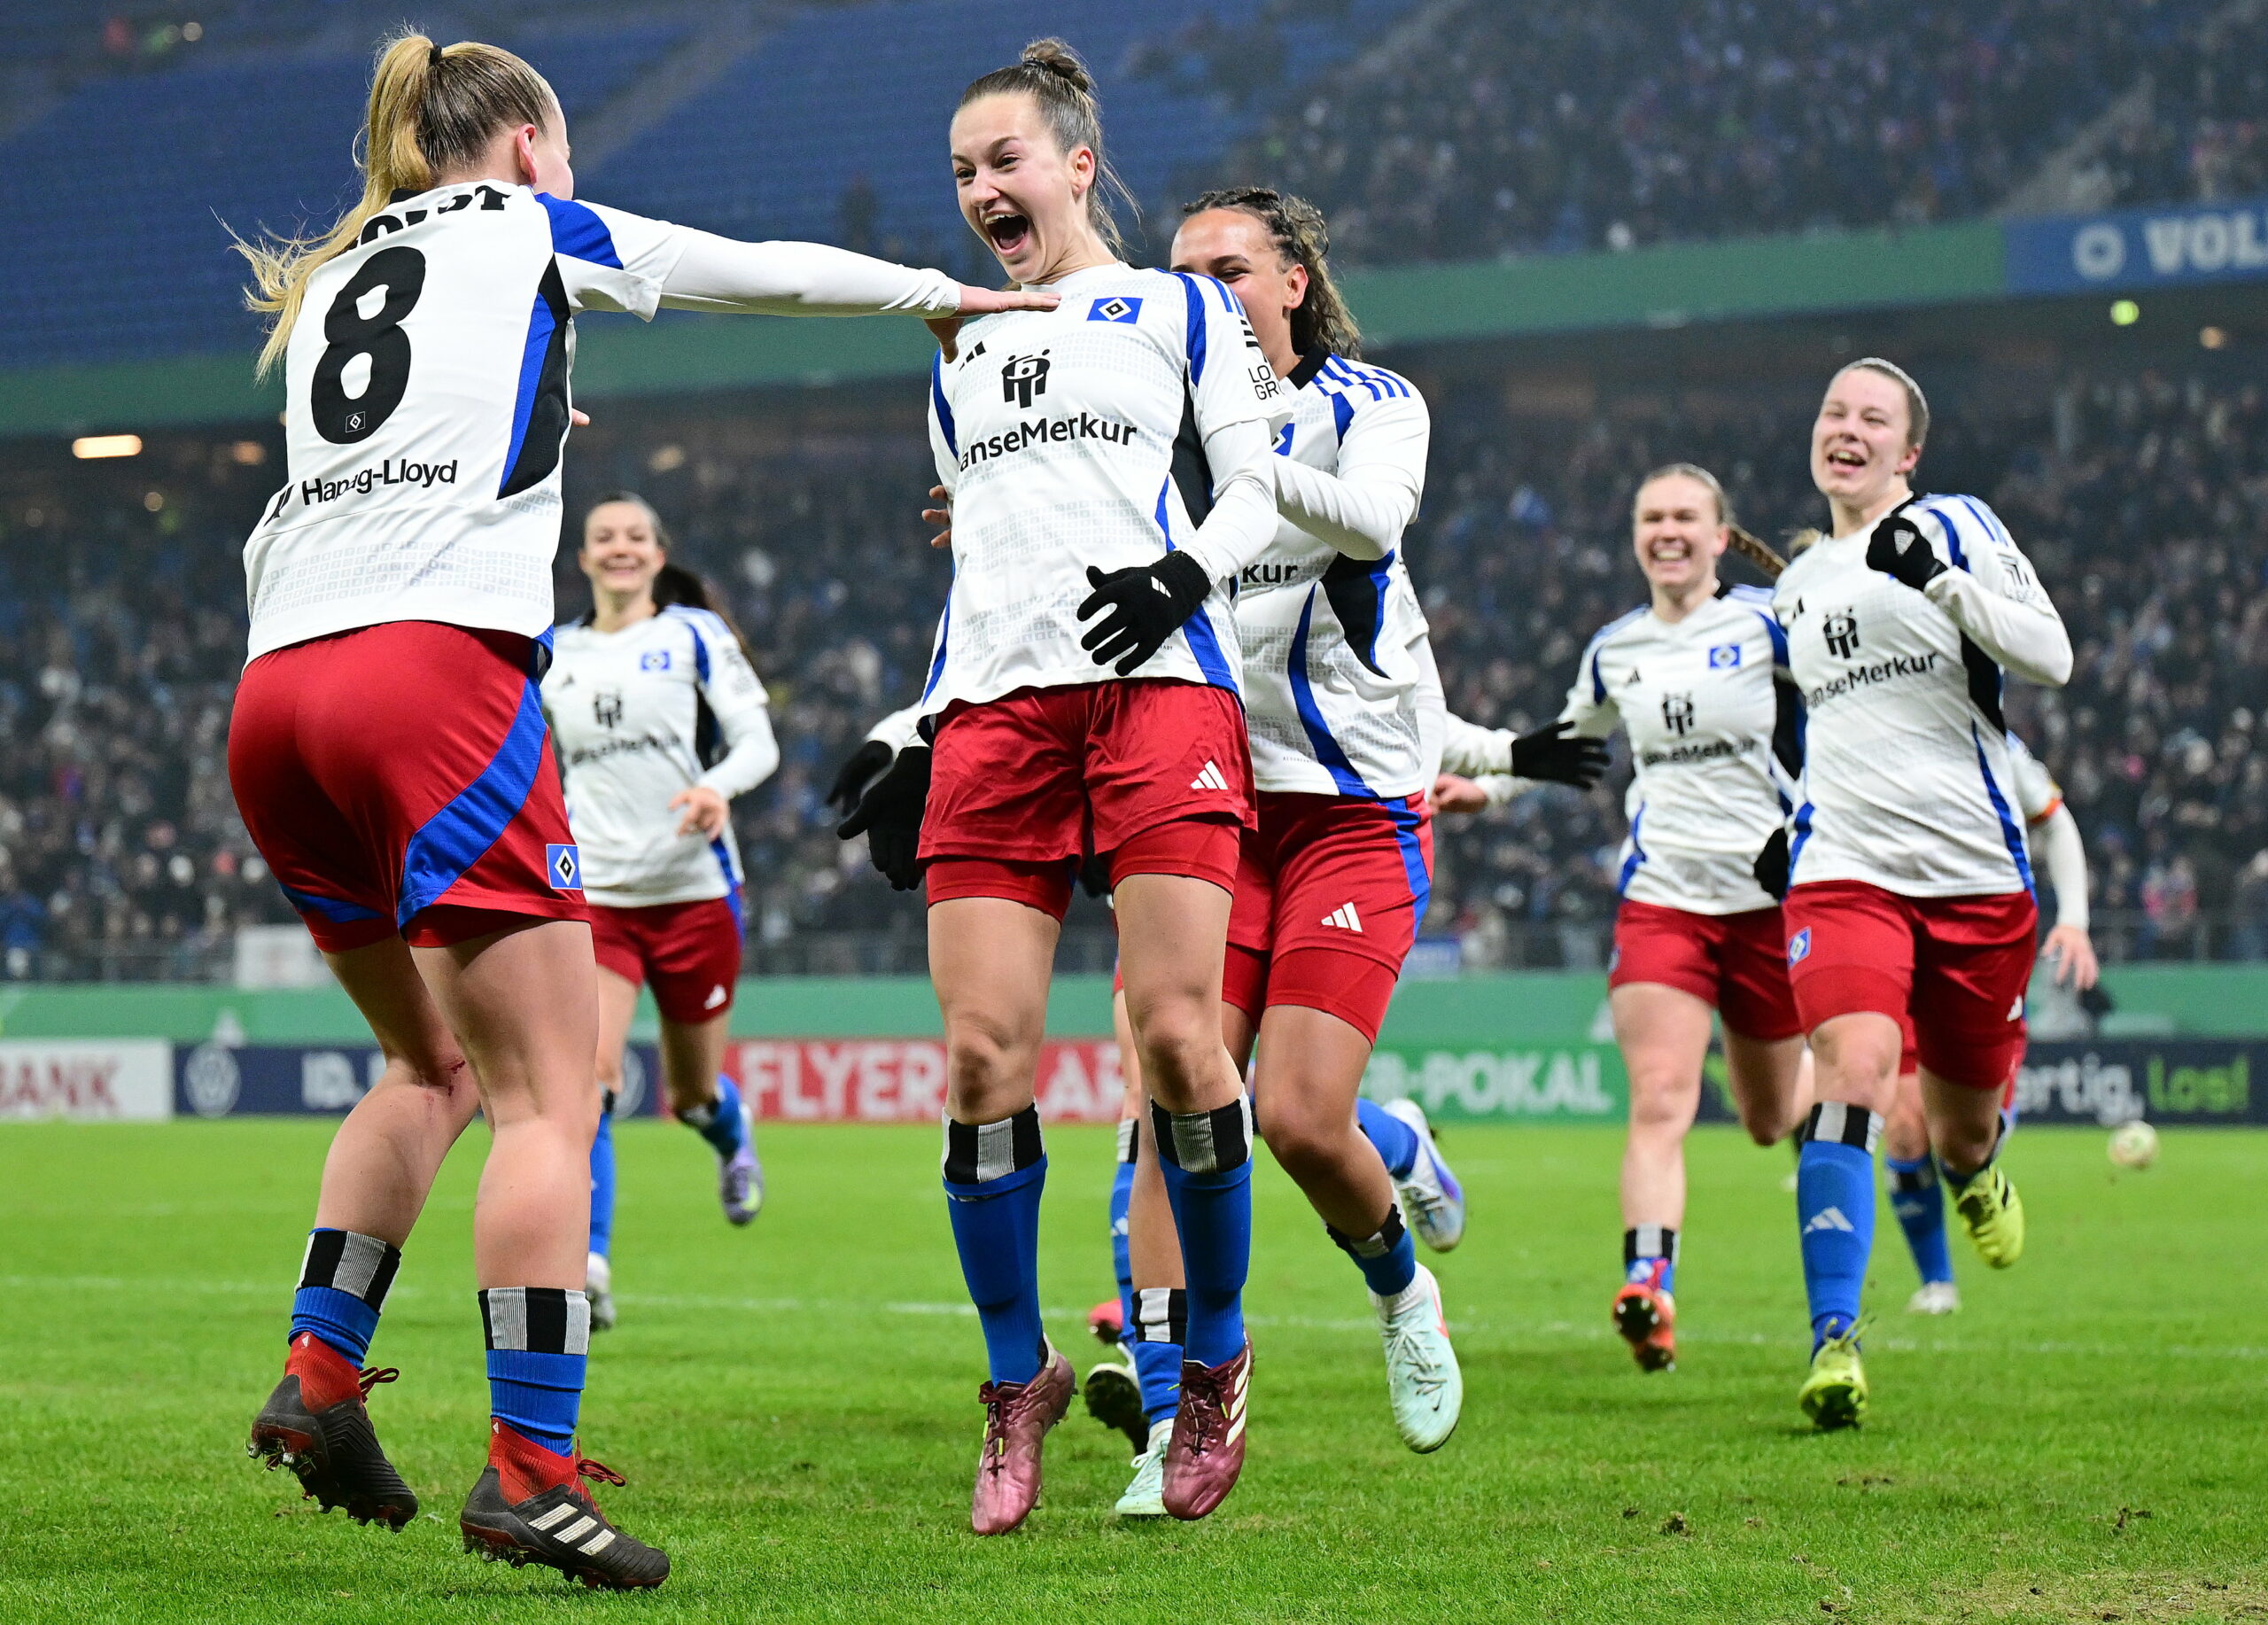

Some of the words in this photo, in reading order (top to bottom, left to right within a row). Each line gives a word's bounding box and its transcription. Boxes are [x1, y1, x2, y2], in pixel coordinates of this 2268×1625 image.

[2142, 213, 2268, 272] VOL
[311, 246, 427, 445] 8
[1247, 364, 1271, 384] LO
[959, 411, 1138, 472] anseMerkur
[1242, 564, 1299, 584] kur
[0, 1056, 122, 1115] ANK
